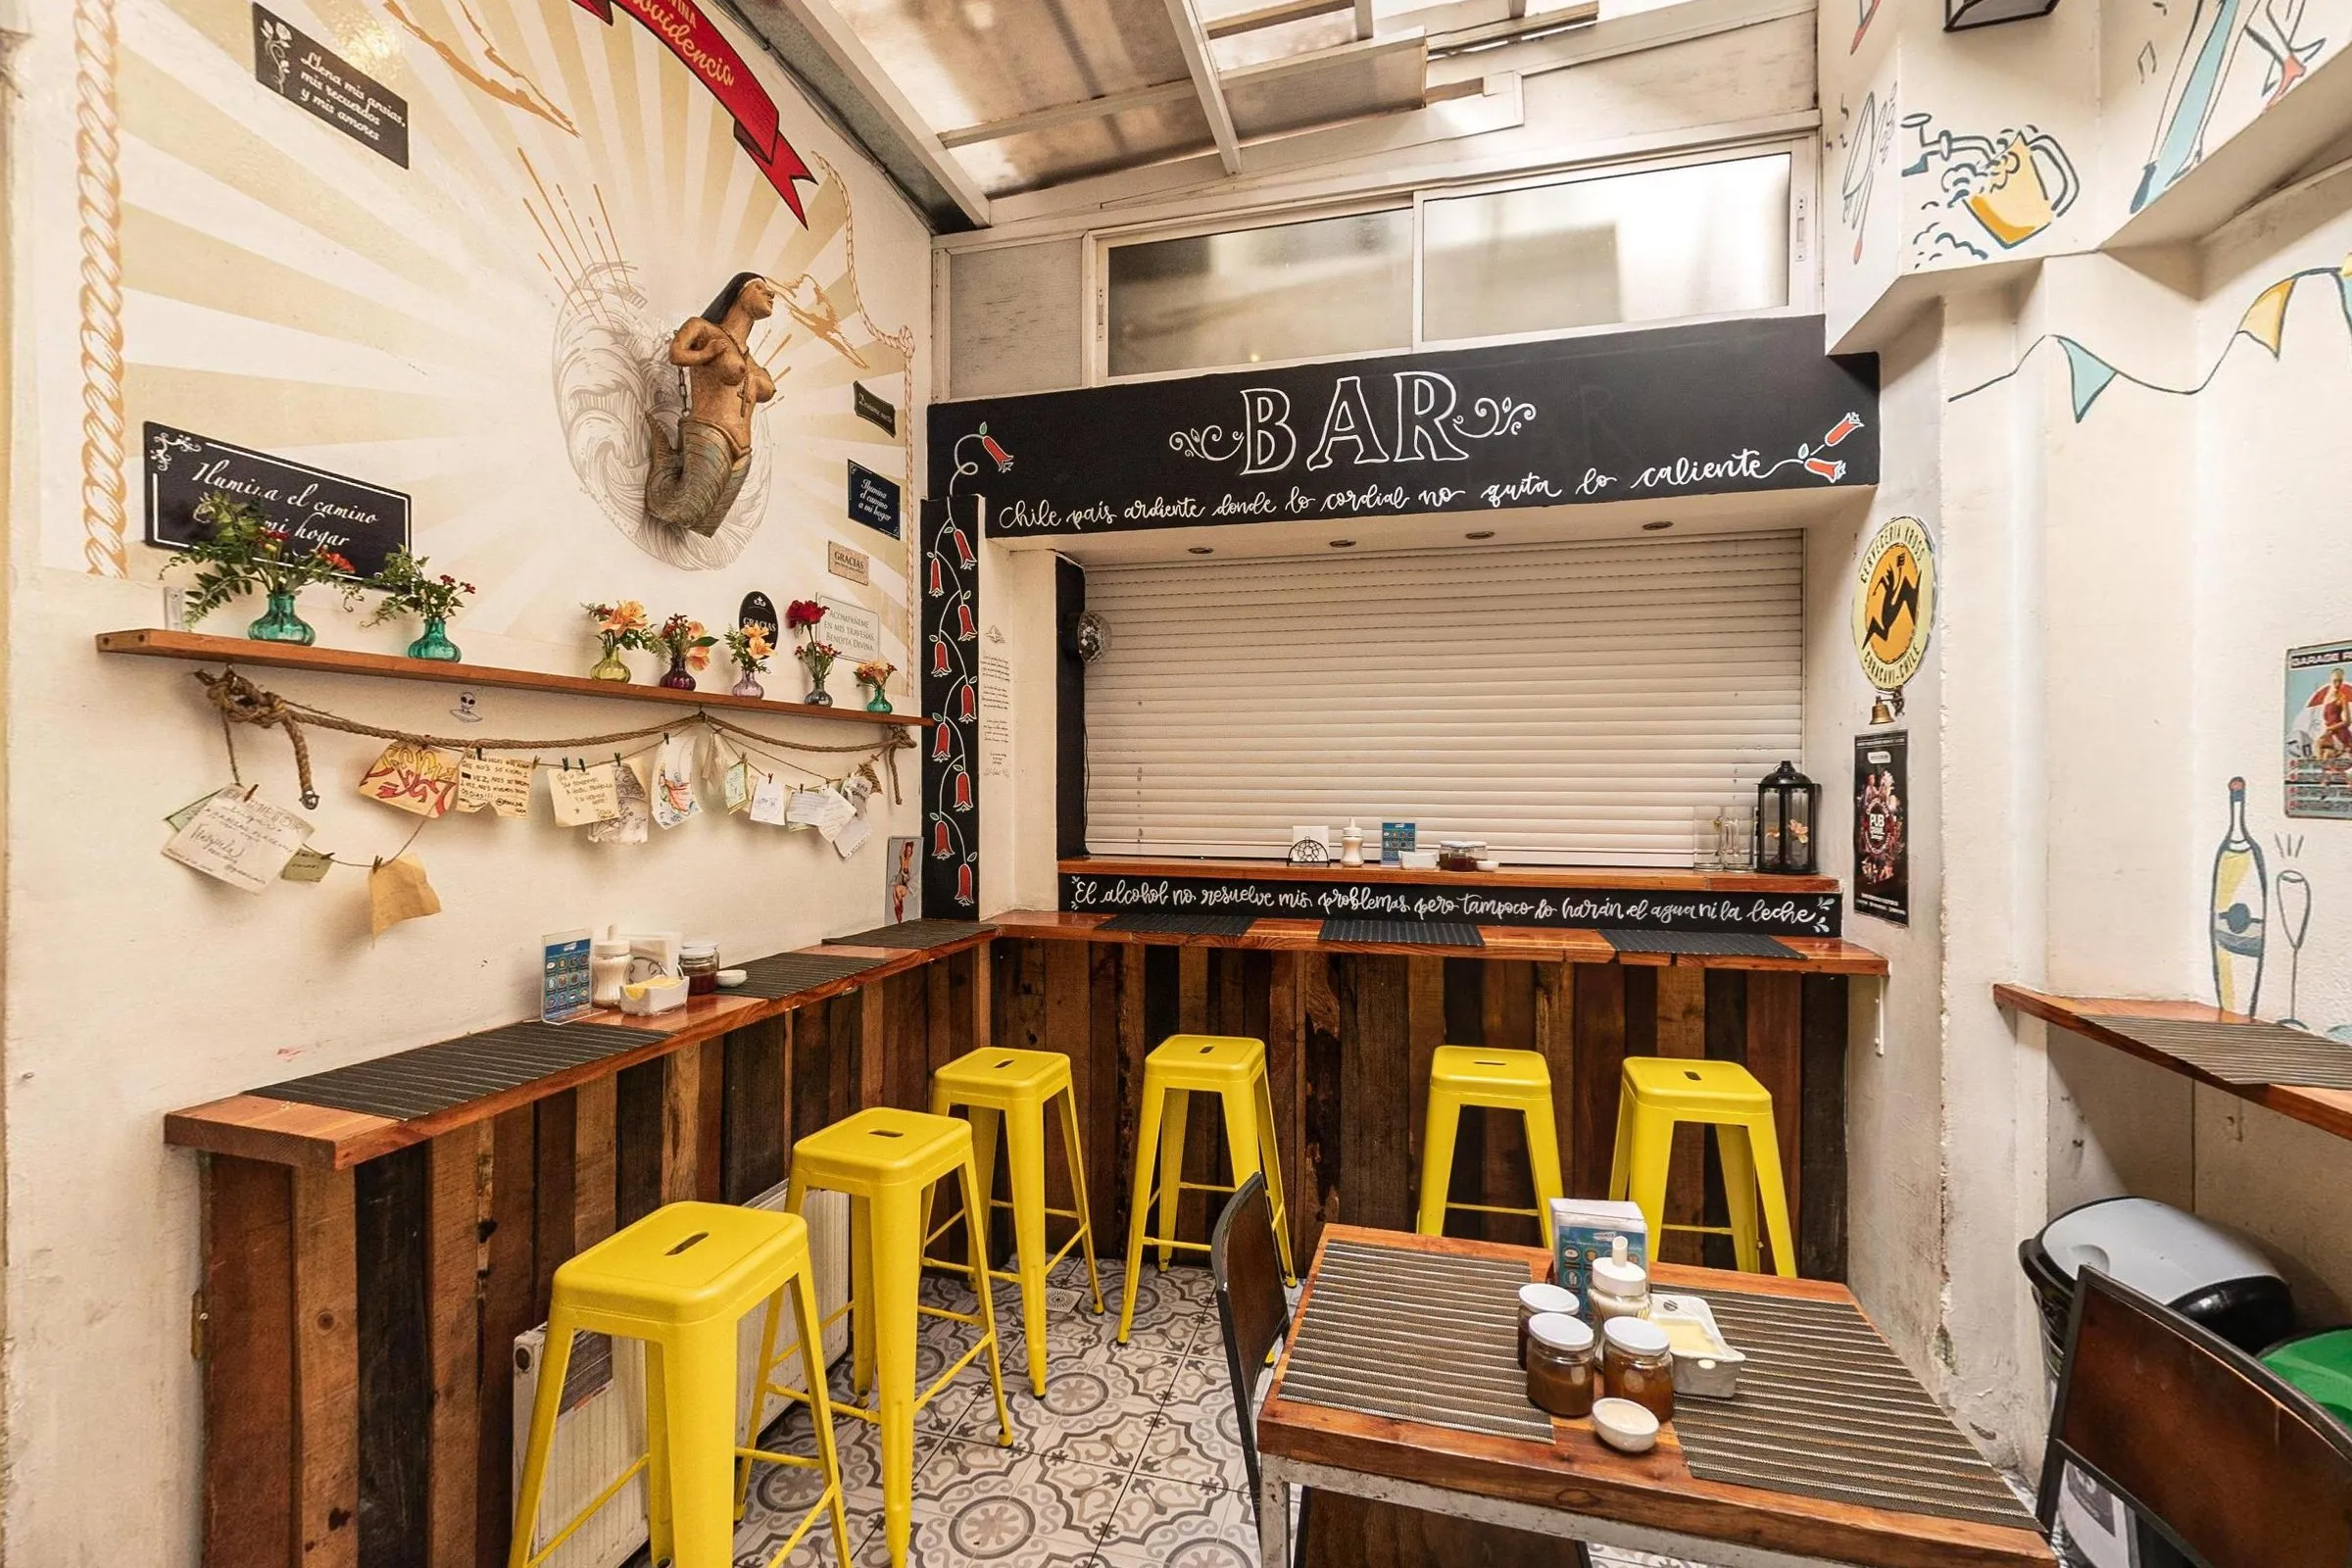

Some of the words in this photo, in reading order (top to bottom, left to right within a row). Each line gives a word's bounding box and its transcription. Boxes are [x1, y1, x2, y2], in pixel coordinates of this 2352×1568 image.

[300, 51, 342, 85] Llena
[344, 84, 365, 100] mis
[300, 72, 322, 91] mis
[325, 84, 380, 125] recuerdos
[300, 88, 310, 102] y
[313, 95, 335, 114] mis
[337, 111, 380, 141] amores
[1240, 370, 1469, 476] BAR
[286, 482, 319, 508] el
[314, 500, 380, 525] camino
[1066, 500, 1117, 529] país
[1124, 496, 1206, 519] ardiente
[1211, 491, 1276, 516] donde
[1285, 486, 1316, 514] lo
[1319, 484, 1409, 511] cordial
[1418, 489, 1466, 508] no
[1481, 471, 1562, 508] quita
[1576, 467, 1618, 495] lo
[1631, 448, 1767, 489] caliente
[293, 512, 351, 558] hogar
[834, 551, 864, 568] GRACIAS
[1869, 812, 1886, 827] PUB
[1074, 881, 1097, 905] El
[1100, 880, 1169, 905] alcohol
[1173, 887, 1197, 906] no
[1200, 885, 1274, 906] resuelve
[1279, 888, 1313, 908] mis
[1317, 887, 1411, 914] problemas
[1413, 893, 1458, 920] pero
[1456, 894, 1533, 920] tampoco
[1535, 898, 1557, 919] lo
[1561, 896, 1624, 920] harán
[1626, 899, 1649, 919] el
[1650, 903, 1698, 924] agua
[1699, 902, 1718, 919] ni
[1720, 900, 1743, 921] la
[1746, 898, 1816, 924] leche
